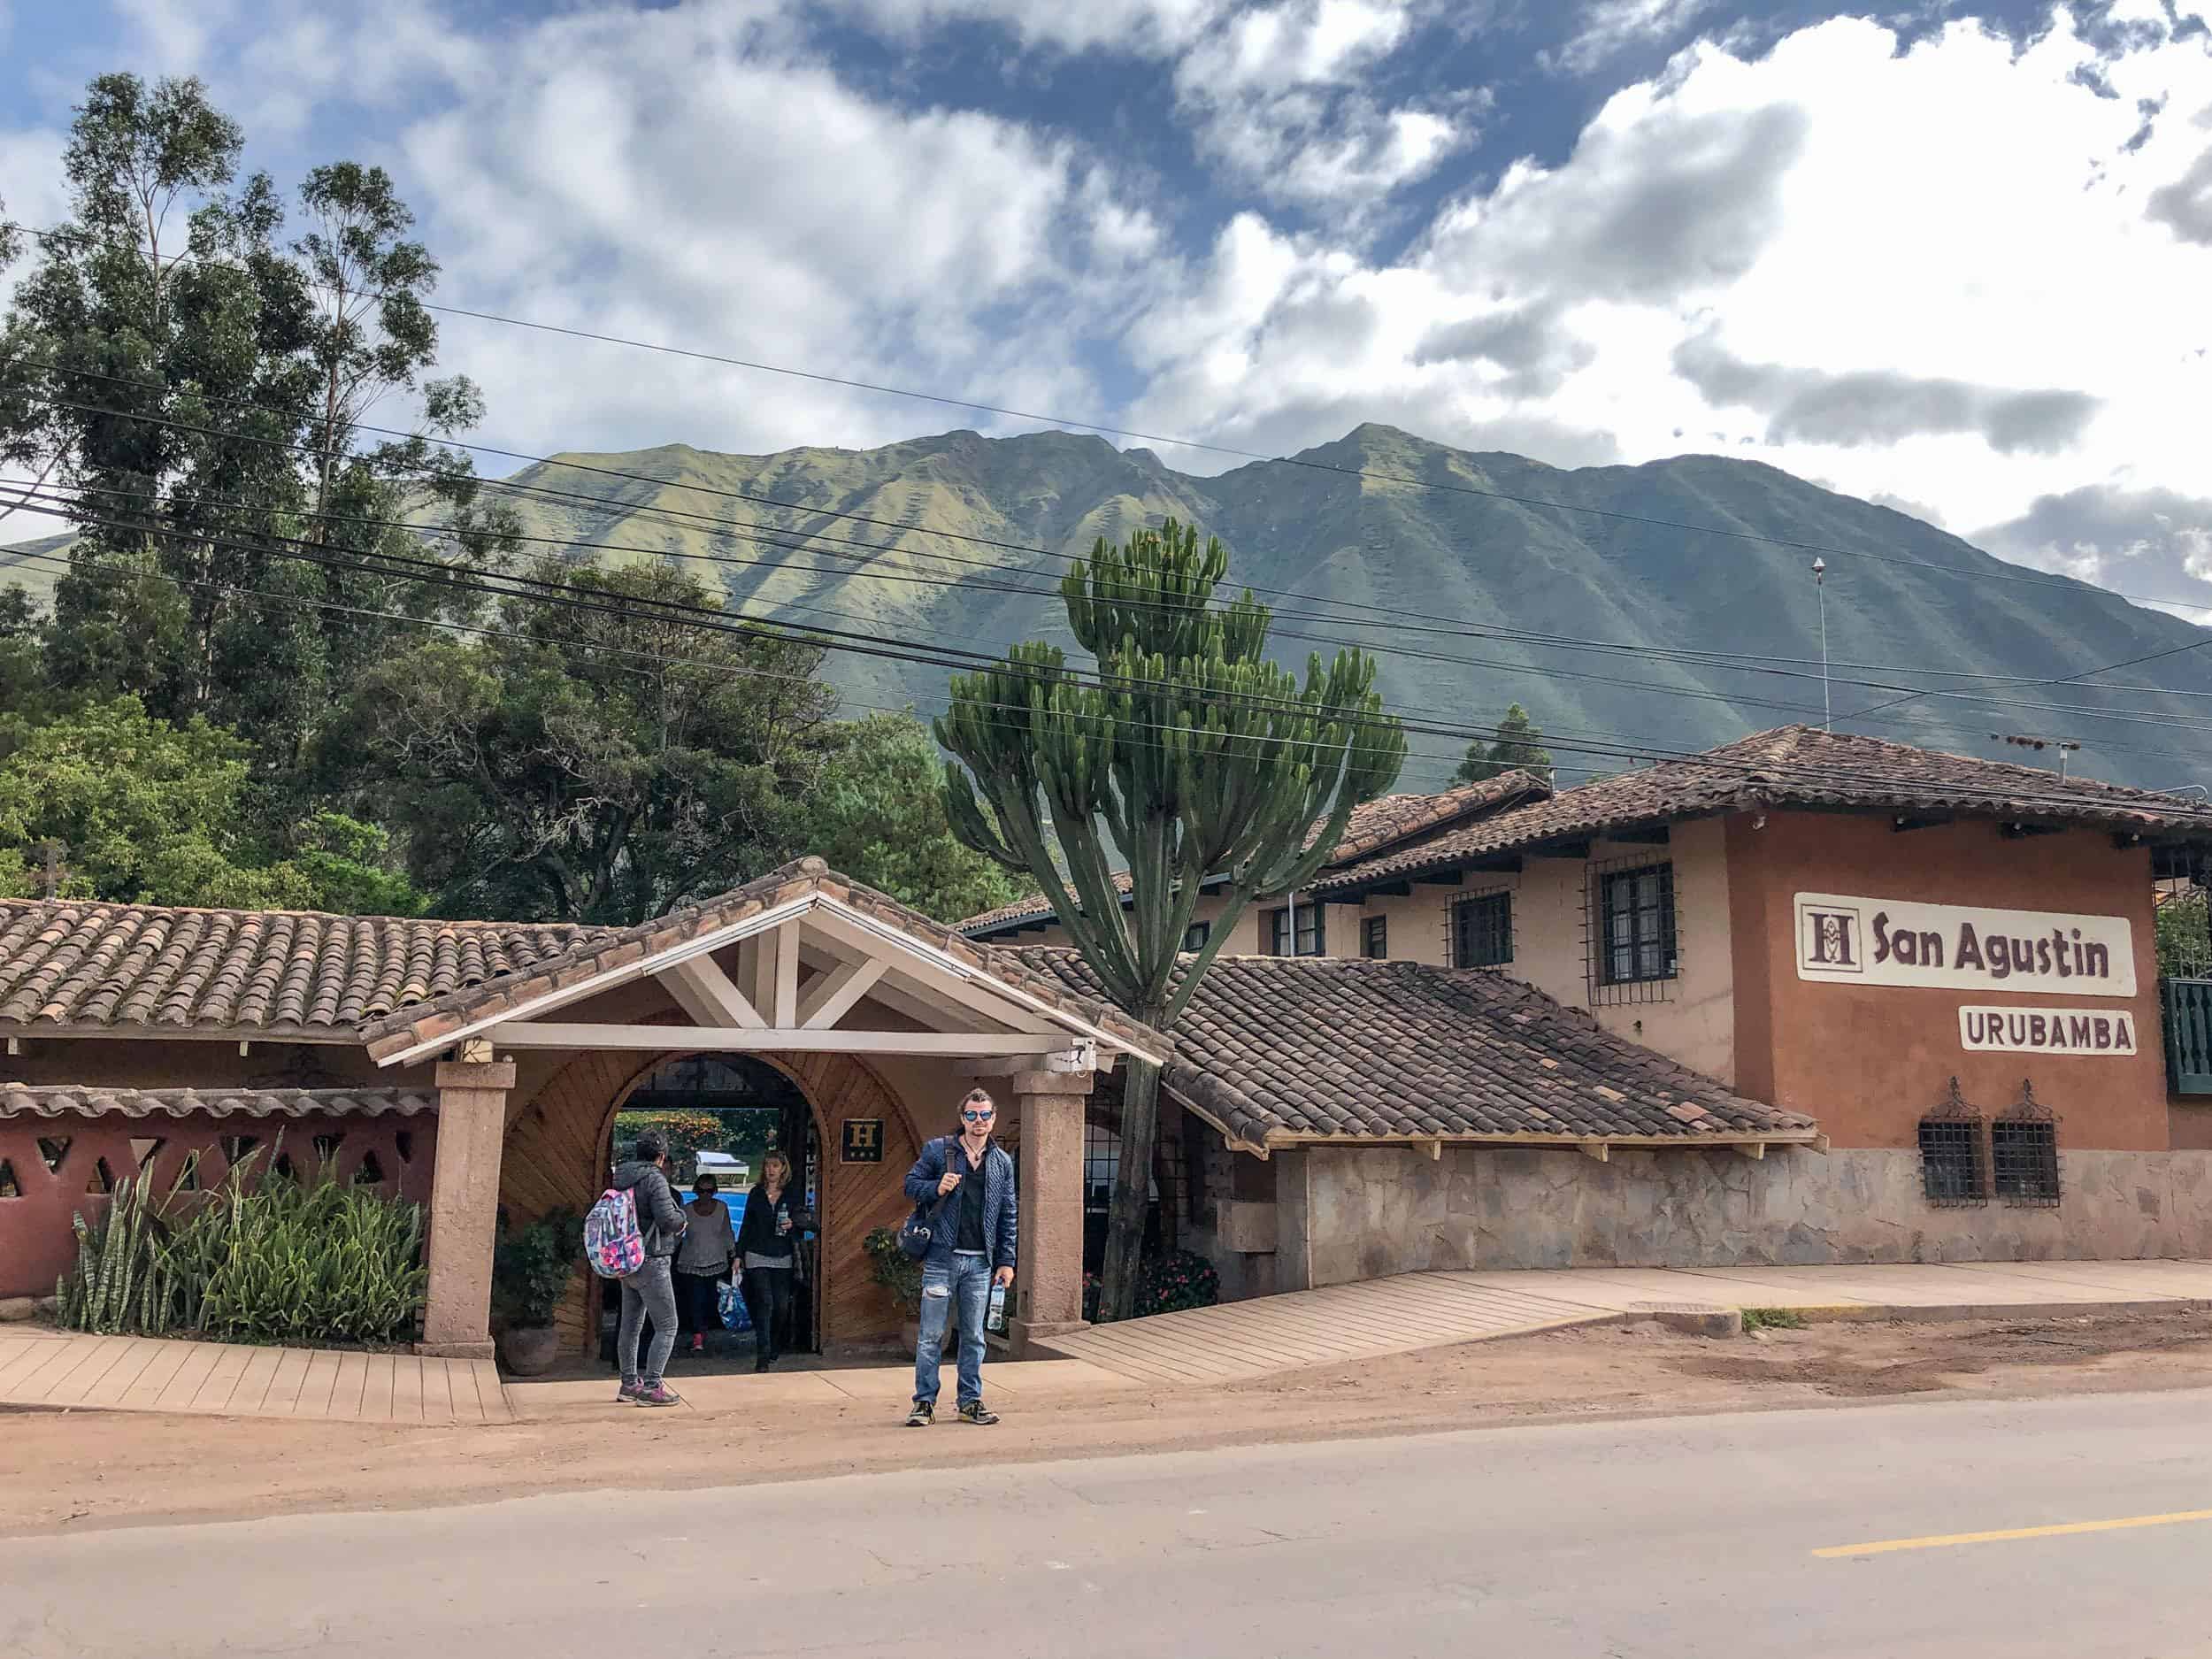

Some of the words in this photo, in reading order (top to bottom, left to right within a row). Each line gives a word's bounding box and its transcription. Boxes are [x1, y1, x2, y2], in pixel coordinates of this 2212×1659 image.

[1871, 911, 1944, 967] San
[1954, 922, 2109, 979] Agustin
[1966, 1011, 2132, 1049] URUBAMBA
[849, 1124, 877, 1148] H
